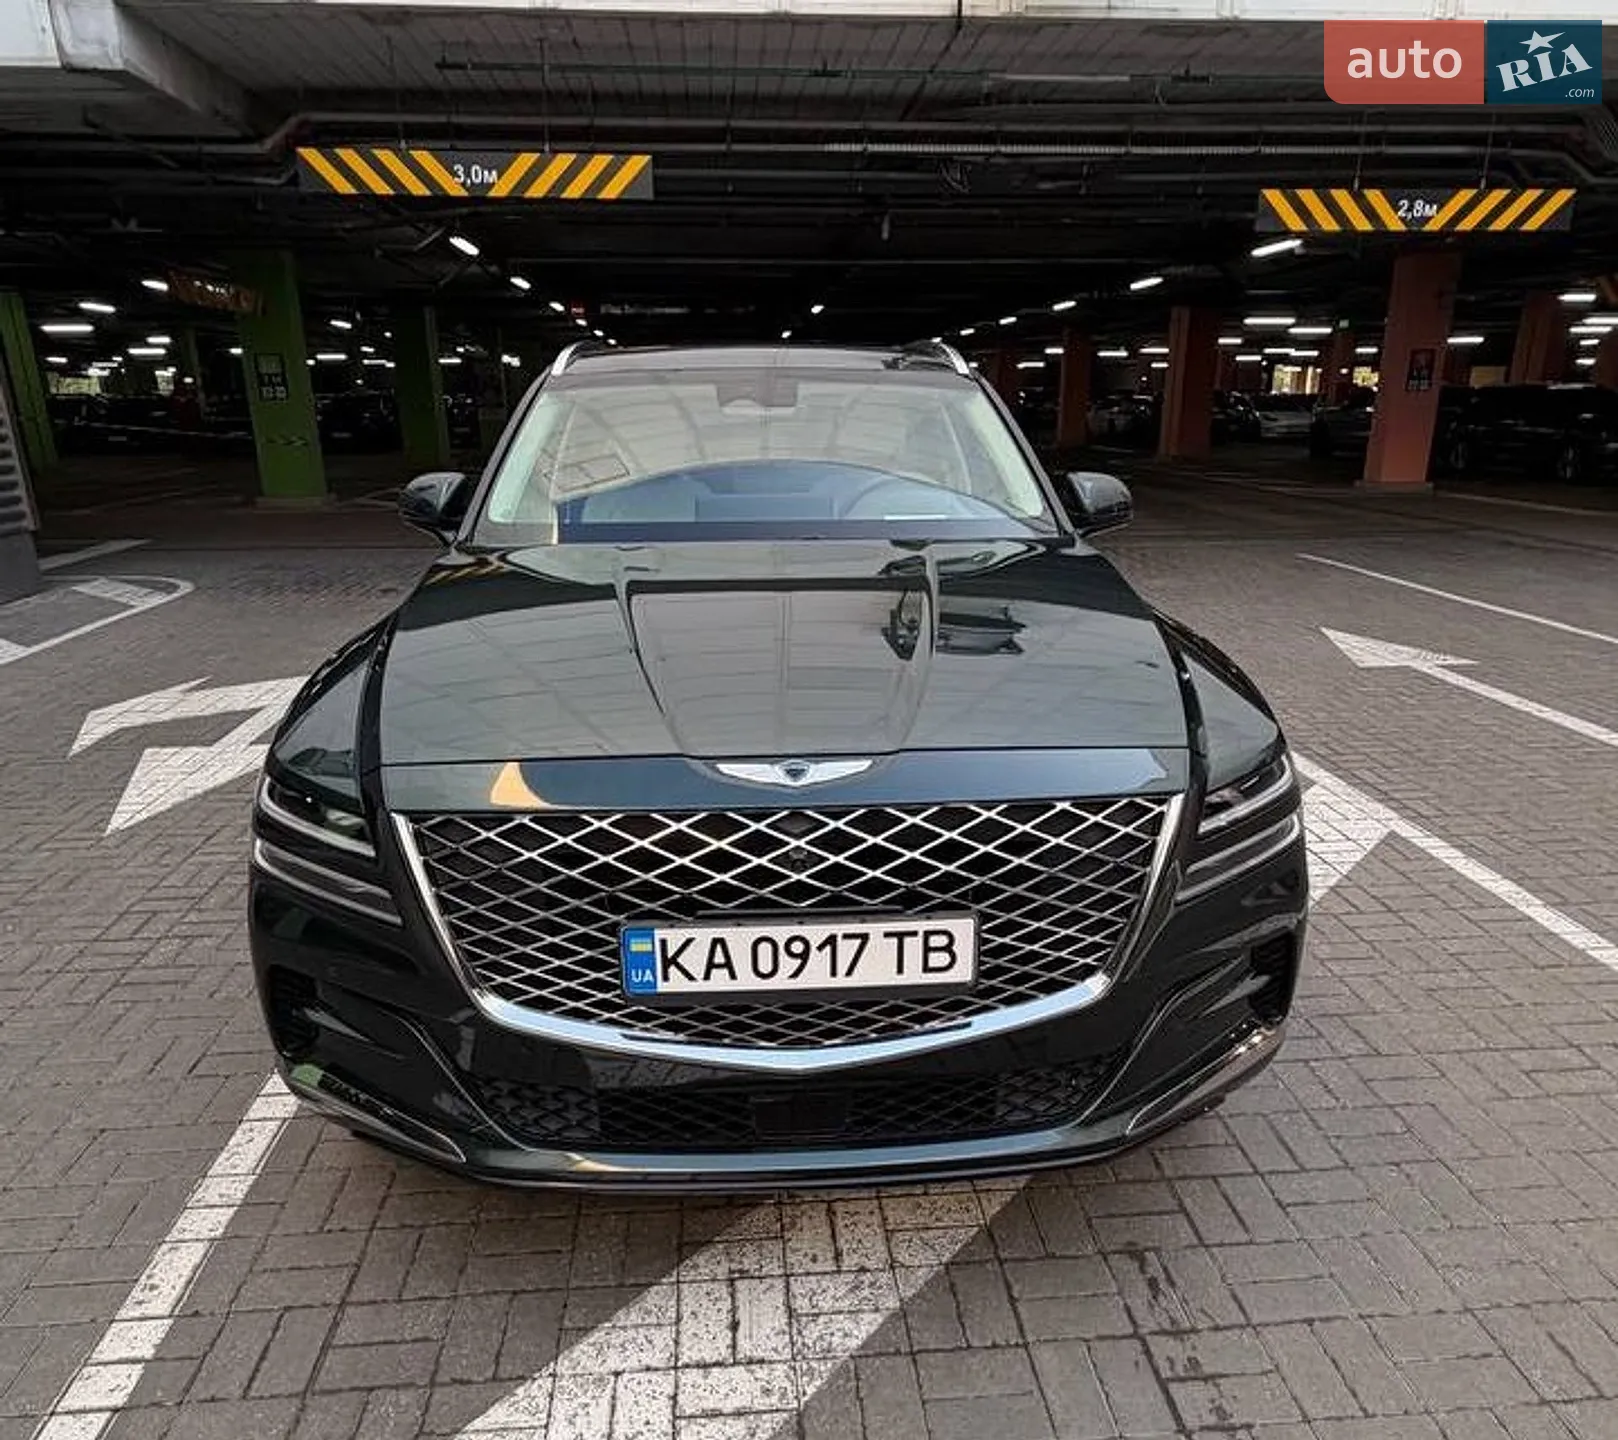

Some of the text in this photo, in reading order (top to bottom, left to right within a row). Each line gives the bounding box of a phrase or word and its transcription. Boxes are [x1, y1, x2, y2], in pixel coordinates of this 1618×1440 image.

[658, 929, 957, 982] KA 0917 TB
[631, 968, 655, 983] UA
